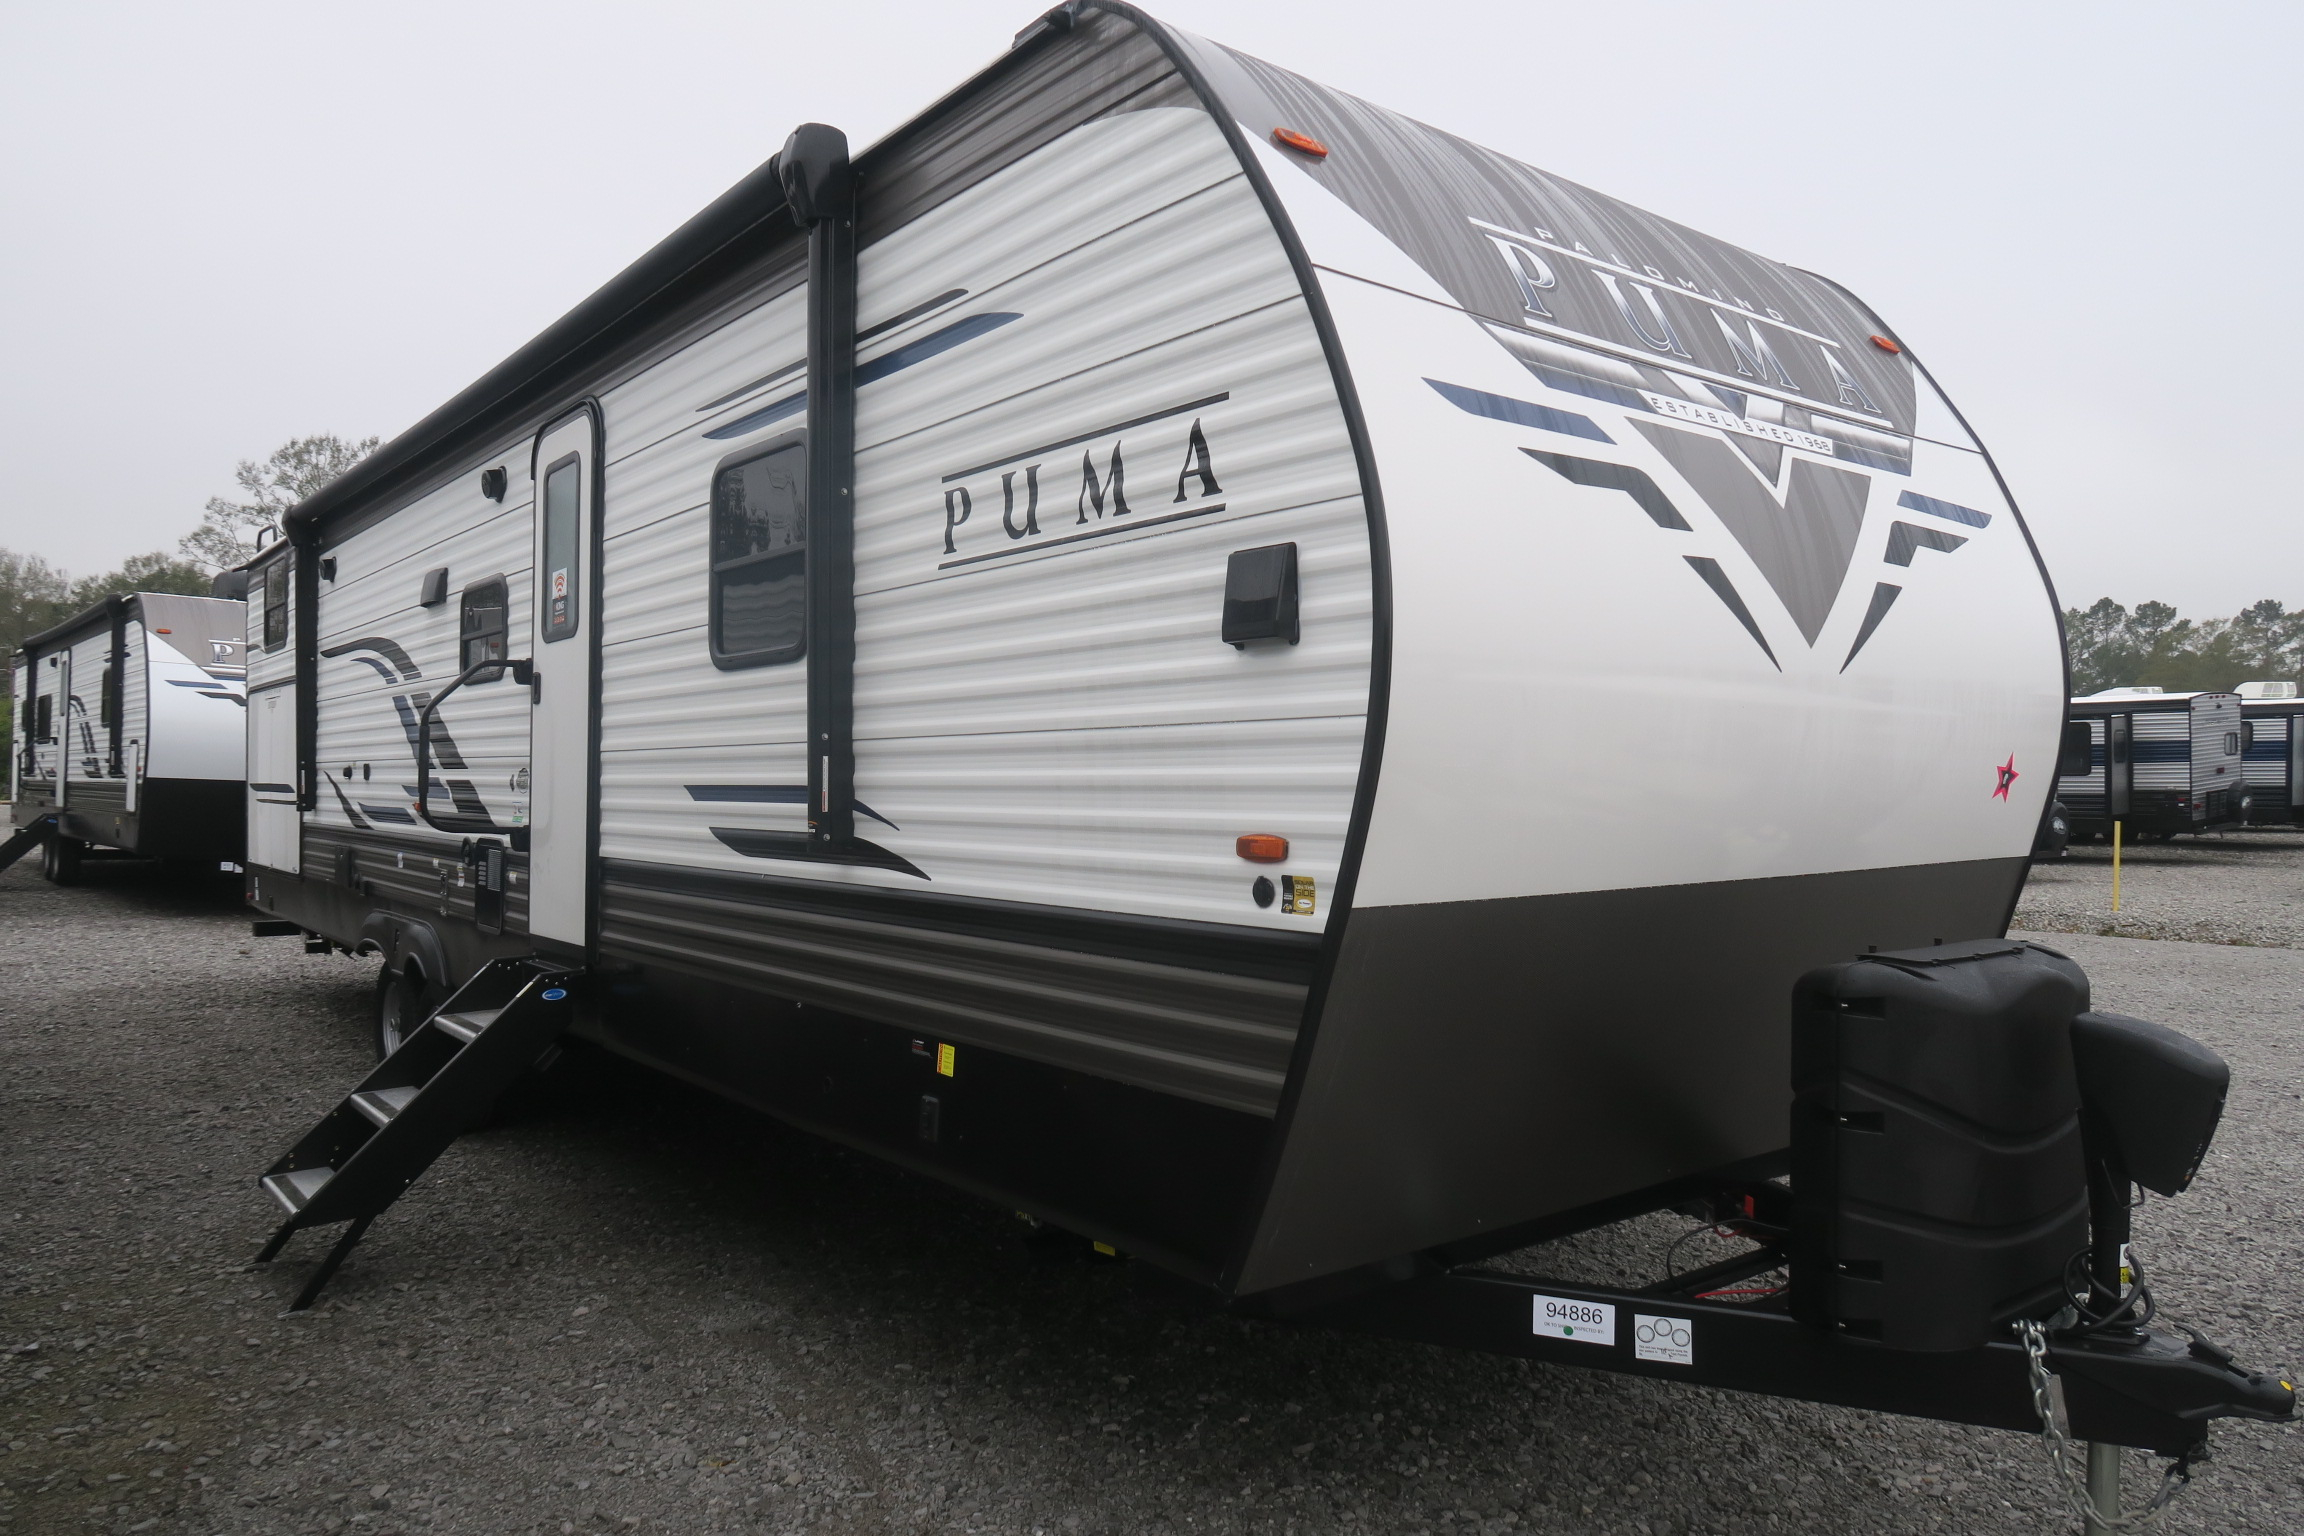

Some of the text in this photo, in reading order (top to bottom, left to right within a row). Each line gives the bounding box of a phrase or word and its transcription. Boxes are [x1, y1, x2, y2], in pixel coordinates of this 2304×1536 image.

[1533, 226, 1785, 322] PALOMINO
[1485, 233, 1883, 414] PUMA
[1650, 397, 1832, 452] ESTABLISHED 1968
[943, 417, 1223, 555] PUMA
[1295, 888, 1315, 897] SIDE
[1546, 1301, 1603, 1325] 94886
[1573, 1325, 1597, 1335] INSPECTED
